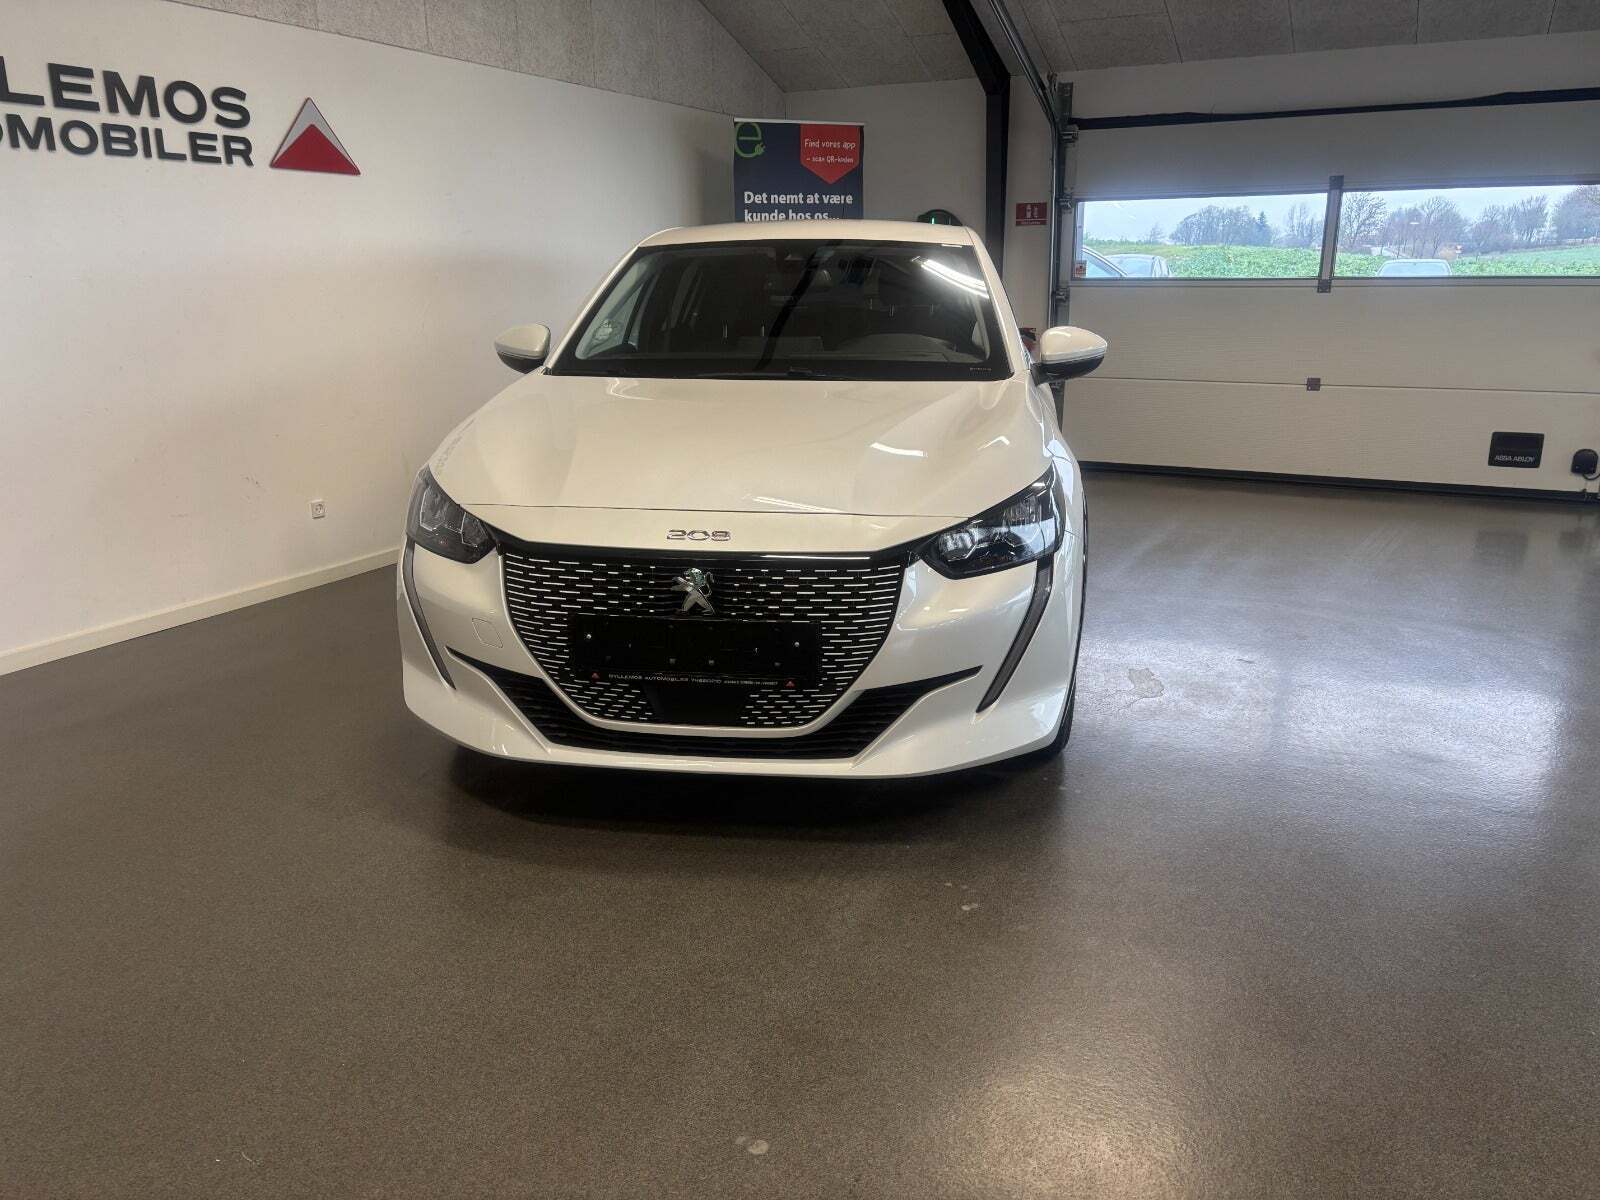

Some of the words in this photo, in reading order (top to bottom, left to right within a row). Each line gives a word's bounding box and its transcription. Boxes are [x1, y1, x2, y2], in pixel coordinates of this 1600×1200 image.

[0, 113, 254, 168] MOBILER
[804, 138, 820, 149] Find
[842, 141, 856, 150] app
[744, 191, 768, 205] Det
[770, 192, 803, 204] nemt
[806, 192, 820, 204] at
[821, 194, 853, 204] være
[744, 209, 786, 222] kunde
[788, 209, 811, 220] hos
[666, 529, 731, 542] 208
